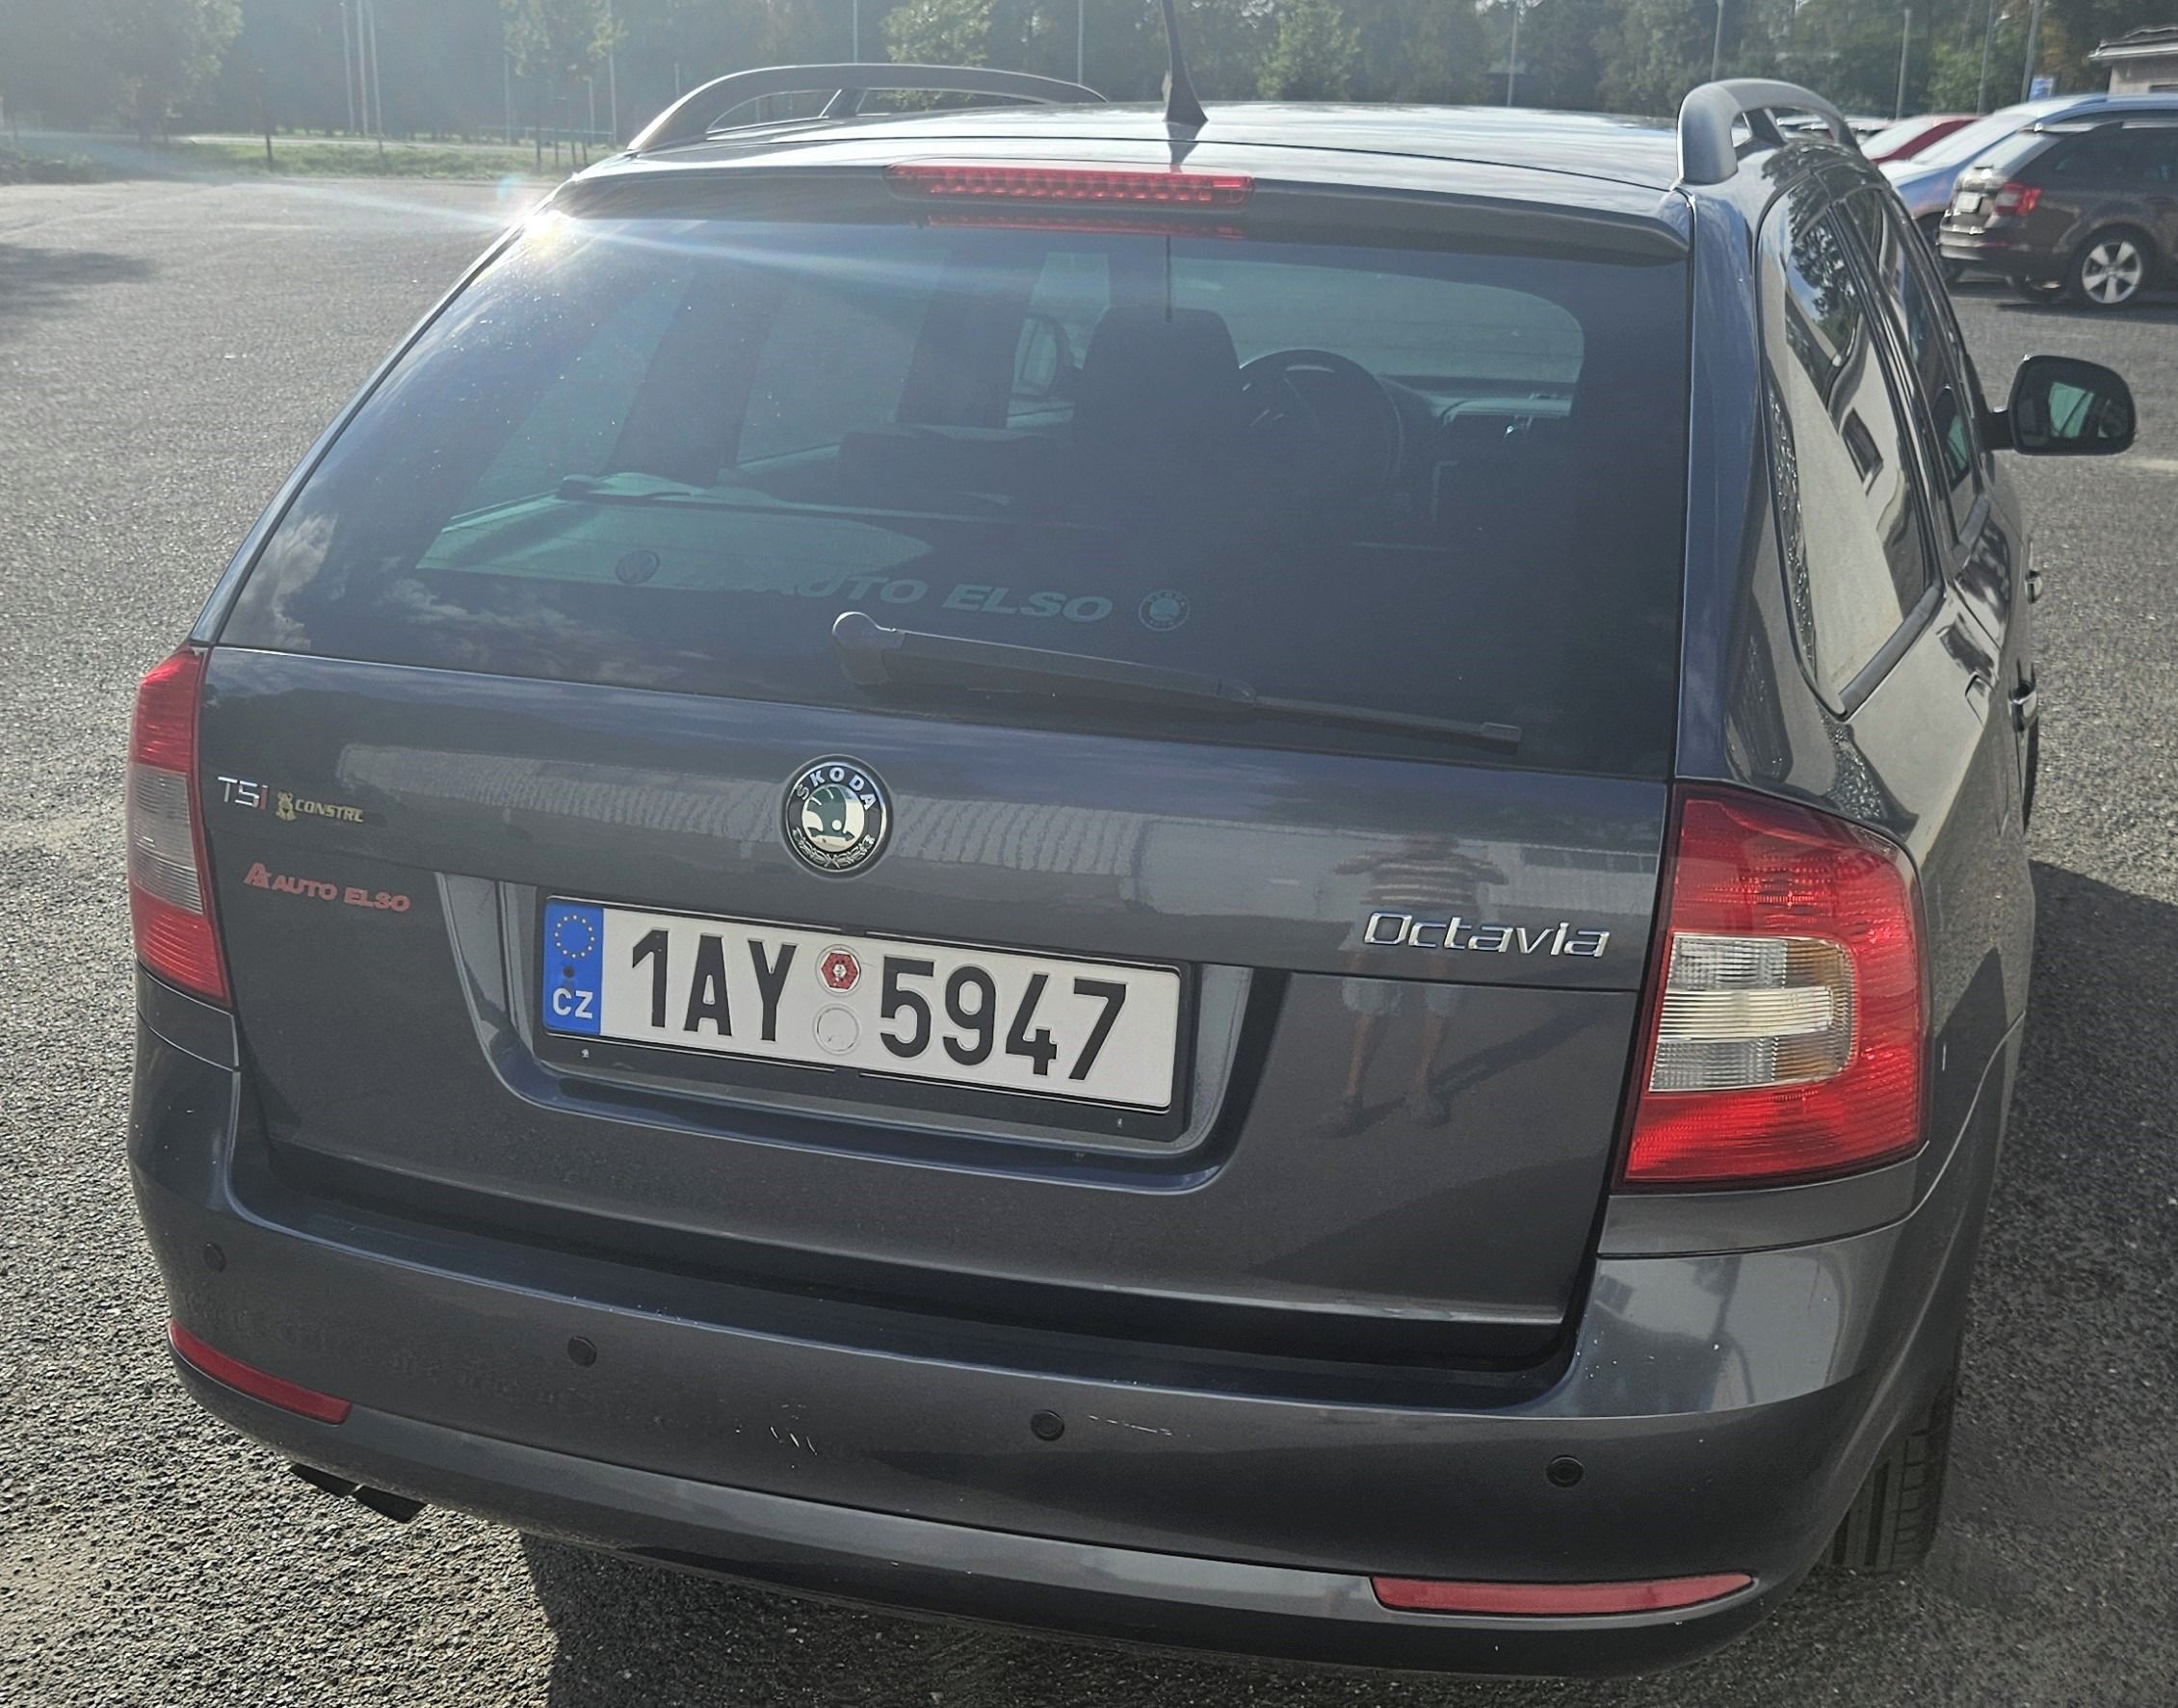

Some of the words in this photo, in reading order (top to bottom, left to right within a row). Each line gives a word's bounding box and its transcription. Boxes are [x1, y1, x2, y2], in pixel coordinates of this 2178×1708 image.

[941, 584, 1114, 622] ELSO
[272, 874, 337, 901] AUTO
[343, 887, 411, 912] ELSO
[1364, 910, 1612, 959] Octavia
[552, 987, 593, 1019] CZ
[632, 929, 797, 1042] 1AY
[880, 956, 1127, 1080] 5947
